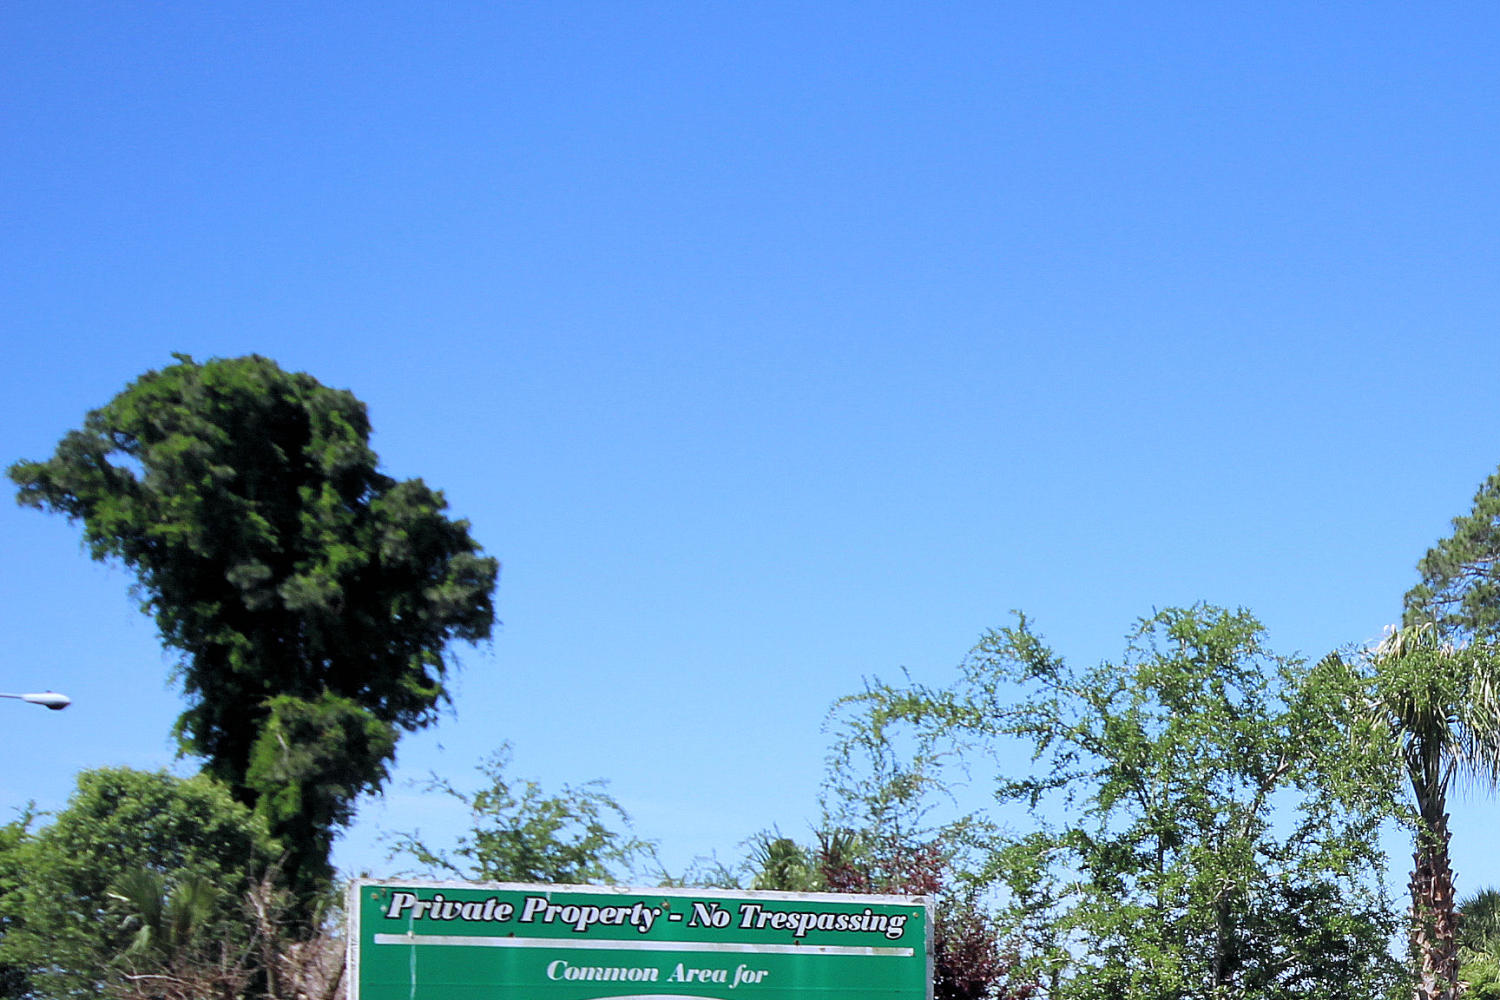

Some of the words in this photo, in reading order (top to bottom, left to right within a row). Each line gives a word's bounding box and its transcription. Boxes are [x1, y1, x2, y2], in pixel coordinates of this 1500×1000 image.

[385, 892, 514, 922] Private
[518, 896, 662, 933] Property
[688, 902, 731, 929] No
[737, 903, 908, 940] Trespassing
[547, 960, 659, 982] Common
[667, 962, 727, 983] Area
[729, 964, 768, 988] for
